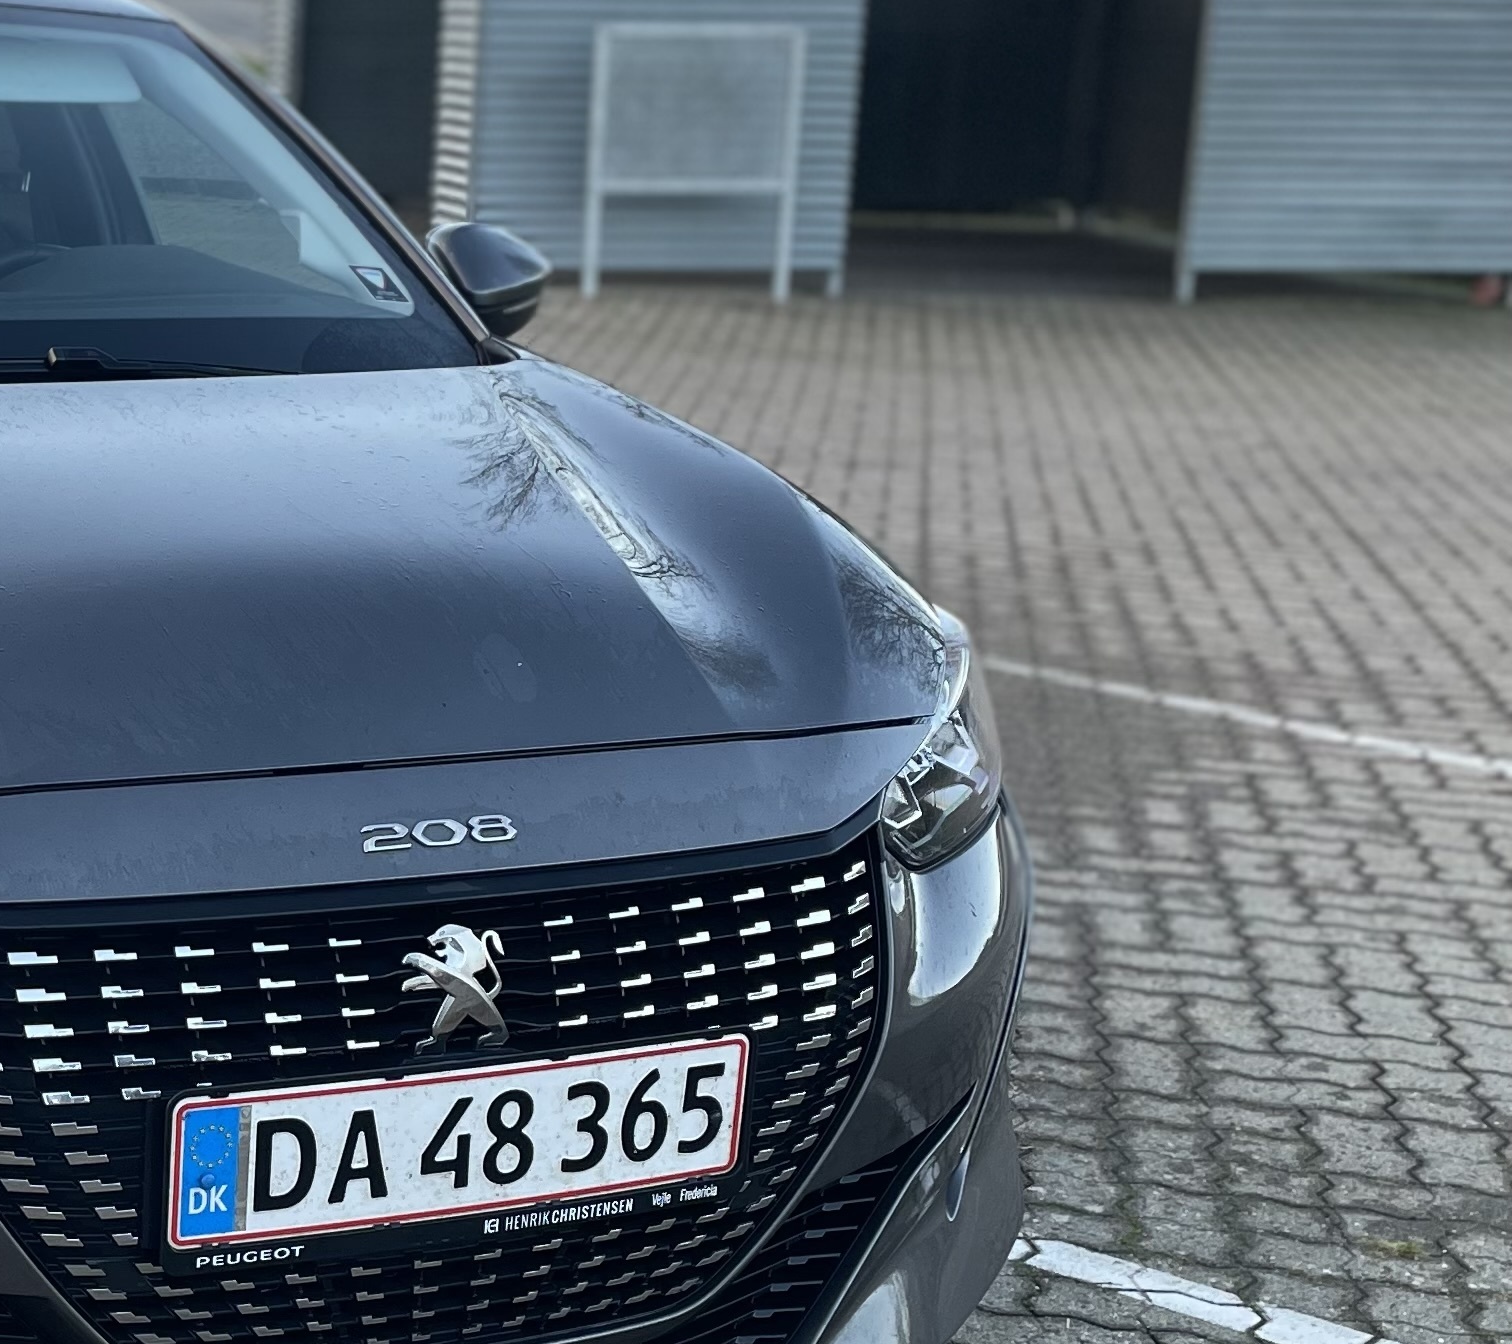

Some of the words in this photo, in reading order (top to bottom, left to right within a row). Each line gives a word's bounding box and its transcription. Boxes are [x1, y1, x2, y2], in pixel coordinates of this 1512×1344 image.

[360, 814, 518, 853] 208
[252, 1109, 388, 1213] DA
[420, 1089, 534, 1188] 48
[560, 1062, 726, 1173] 365
[188, 1184, 228, 1215] DK
[651, 1191, 672, 1208] Vejle
[195, 1245, 305, 1269] PEUGEOT
